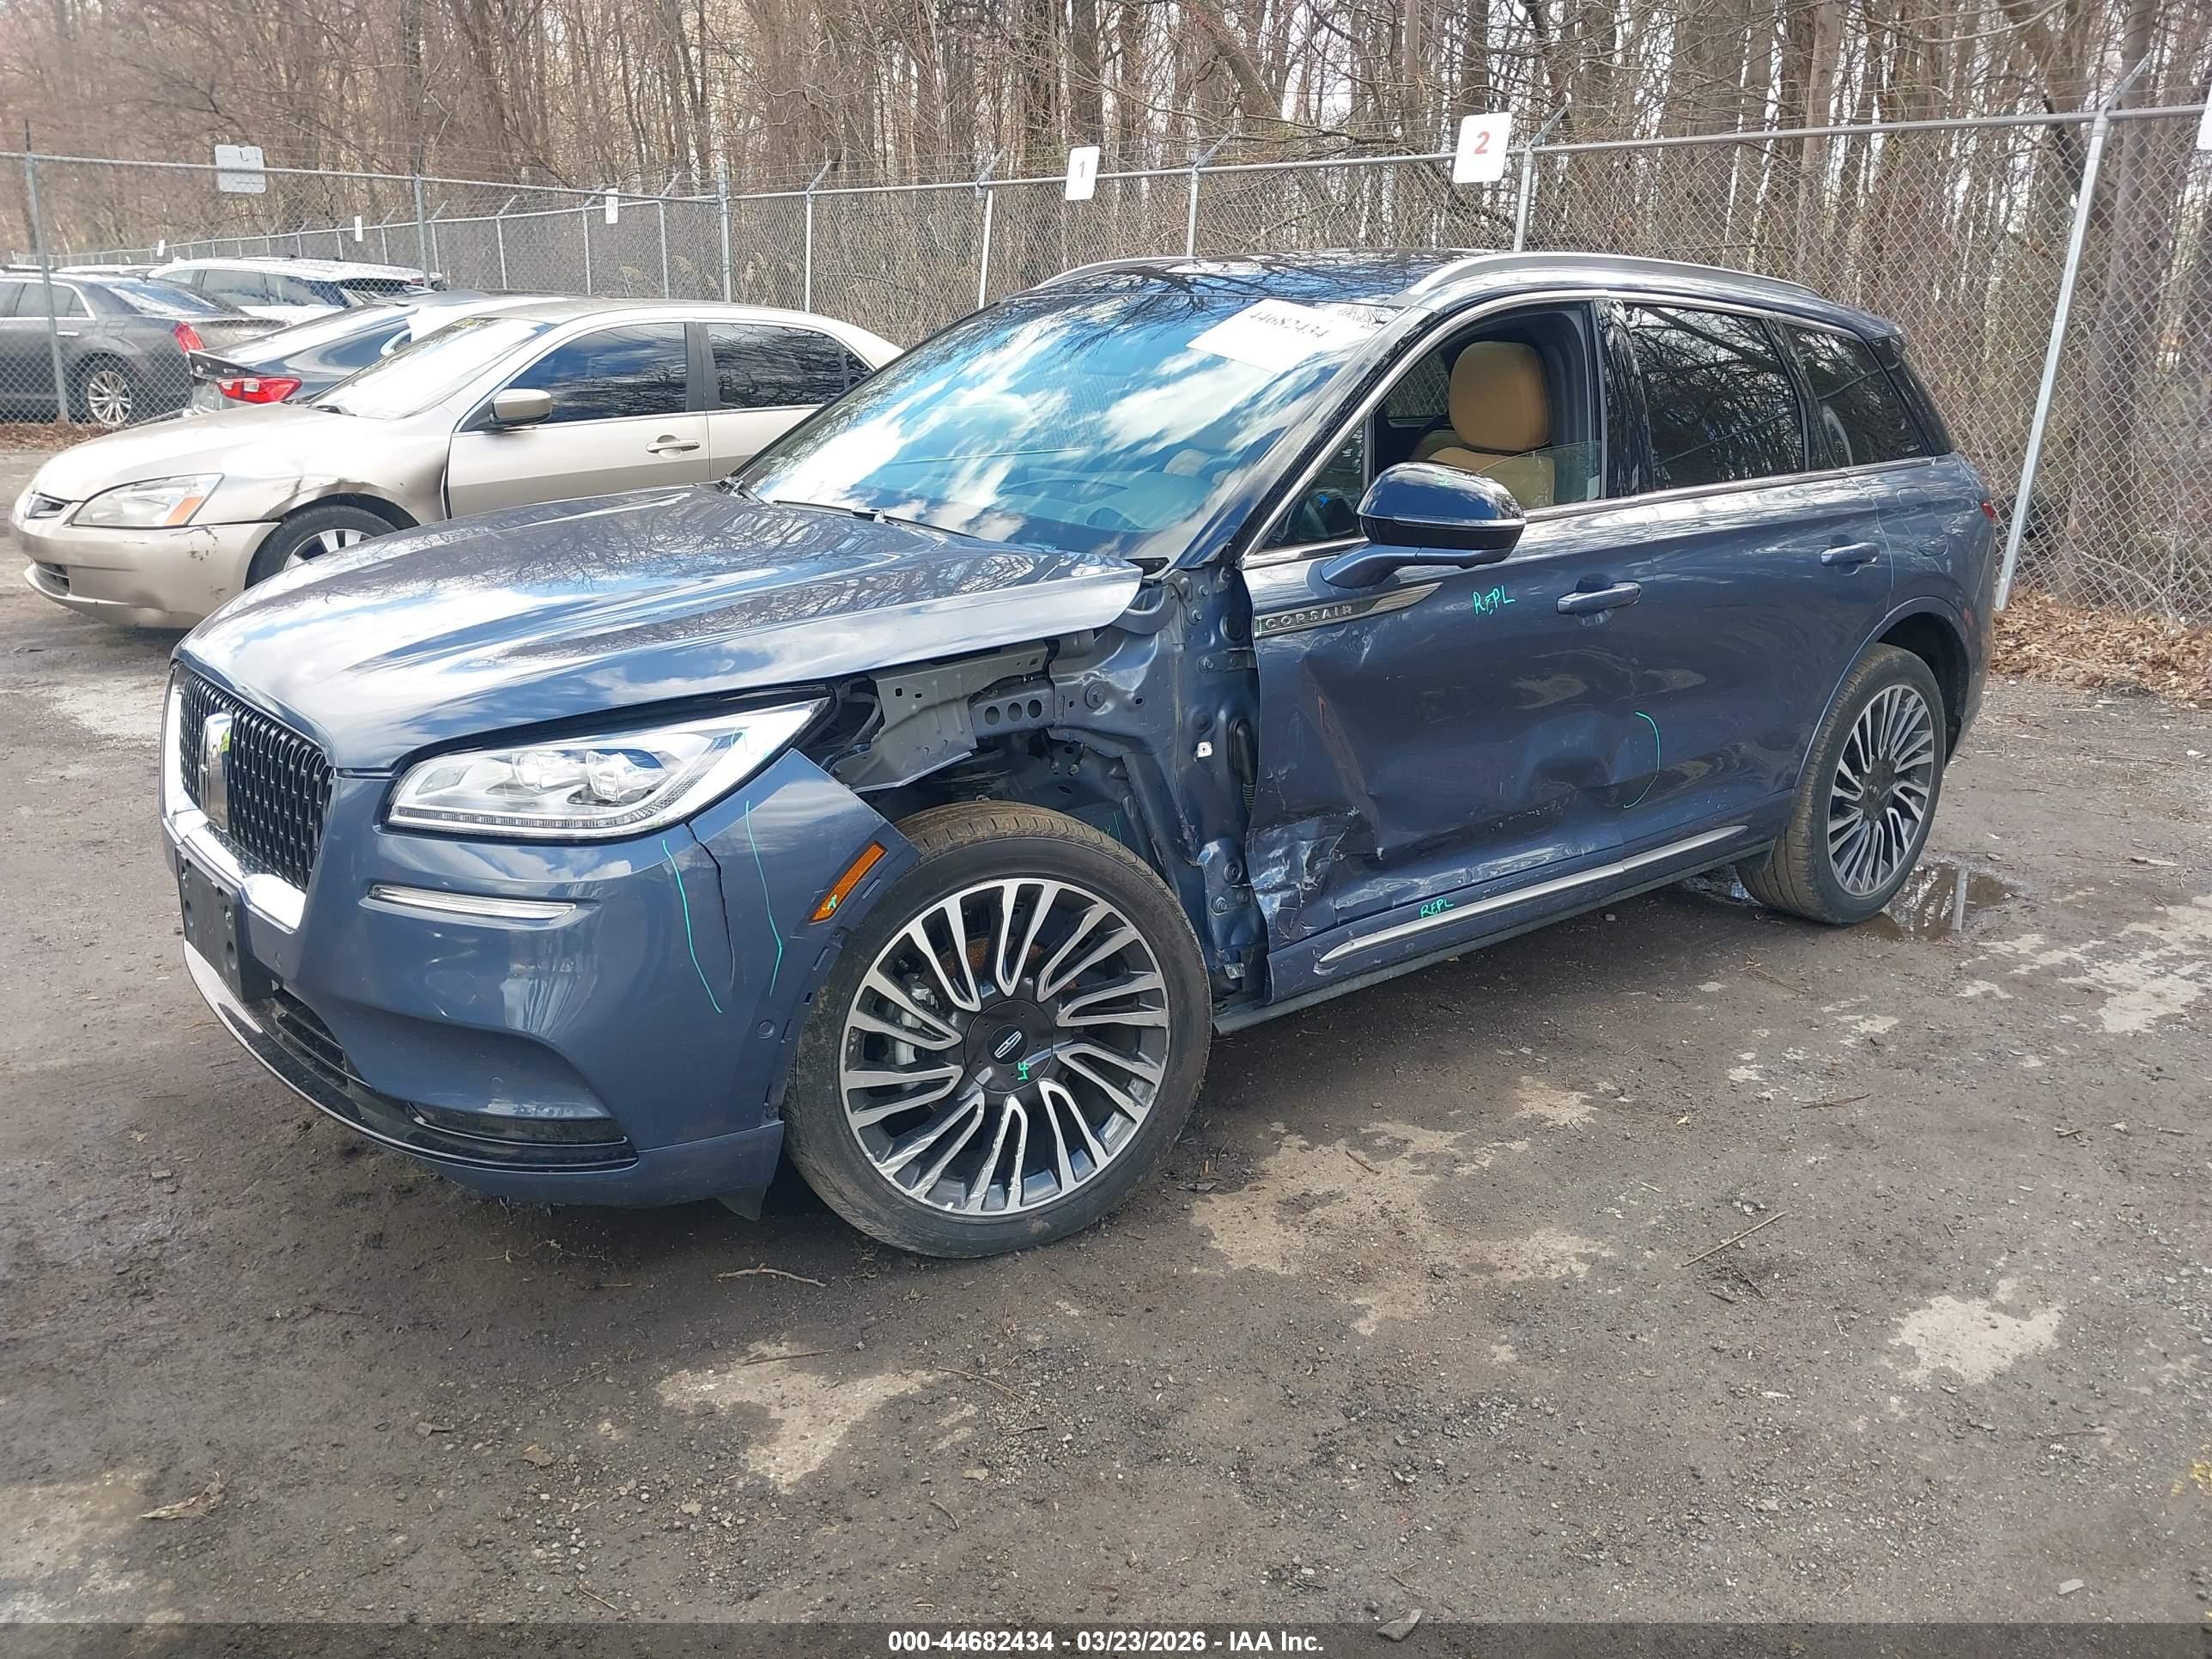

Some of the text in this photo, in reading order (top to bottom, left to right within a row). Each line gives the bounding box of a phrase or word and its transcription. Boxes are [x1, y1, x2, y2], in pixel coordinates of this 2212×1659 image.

[1474, 131, 1491, 155] 2
[1079, 161, 1085, 179] 1
[1473, 585, 1516, 615] REPL
[1266, 605, 1353, 629] CORSAIR
[1420, 898, 1455, 918] REPL
